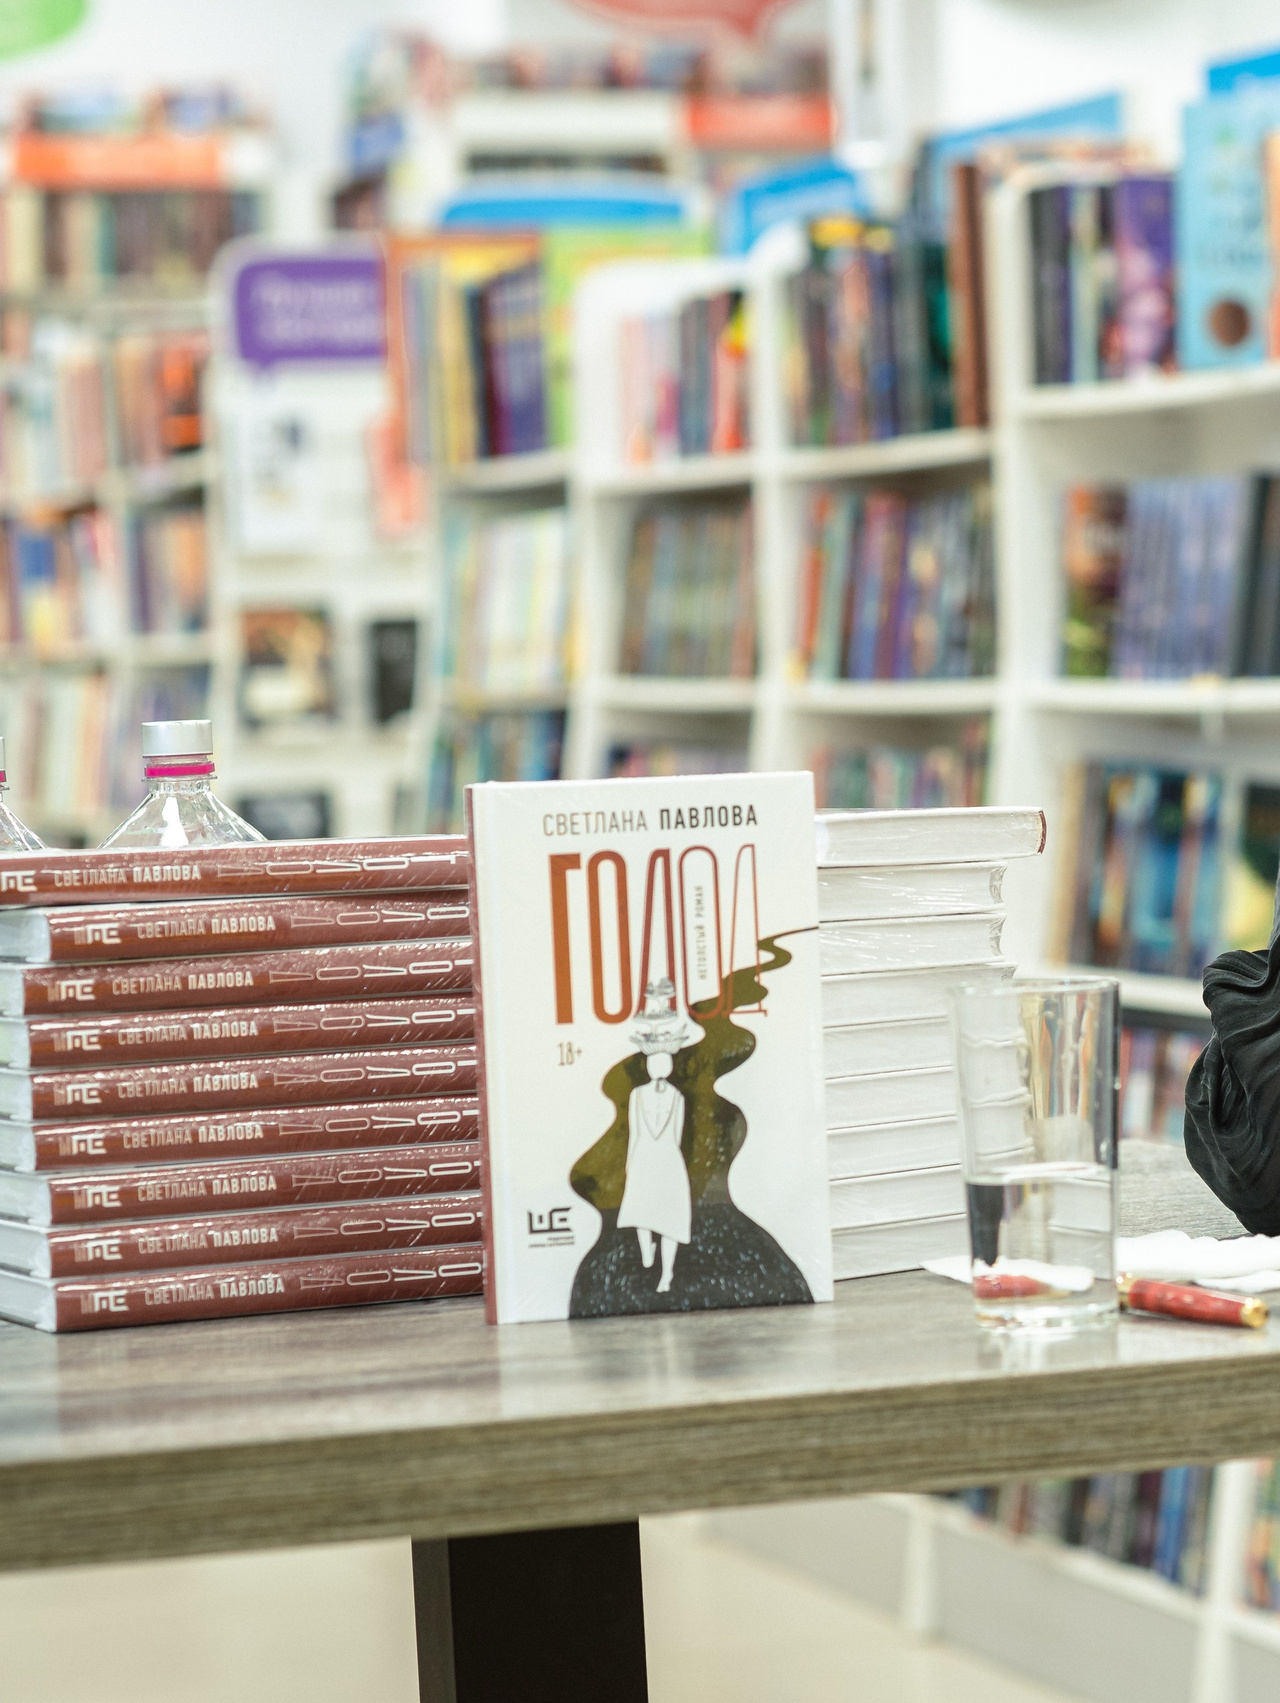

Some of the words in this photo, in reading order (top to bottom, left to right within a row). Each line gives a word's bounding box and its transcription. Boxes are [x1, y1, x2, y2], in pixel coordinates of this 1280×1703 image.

[543, 810, 648, 836] СВЕТЛАНА
[660, 804, 758, 830] ПАВЛОВА
[54, 866, 127, 886] СВЕТЛАНА
[133, 862, 201, 881] ПАВЛОВА
[694, 884, 705, 919] РОМАН
[137, 919, 206, 940] СВЕТЛАНА
[211, 914, 276, 934] ПАВЛОВА
[548, 844, 768, 1025] ГОЛОД
[112, 976, 182, 995] СВЕТЛАНА
[187, 971, 254, 990] ПАВЛОВА
[118, 1025, 188, 1046] СВЕТЛАНА
[193, 1020, 259, 1039] ПАВЛОВА
[557, 1042, 582, 1067] 18+
[117, 1077, 188, 1098] СВЕТЛАНА
[193, 1070, 259, 1090] ПАВЛОВА
[123, 1130, 193, 1149] СВЕТЛАНА
[198, 1124, 264, 1142] ПАВЛОВА
[137, 1182, 207, 1202] СВЕТЛАНА
[212, 1175, 277, 1195] ПАВЛОВА
[138, 1234, 207, 1255] СВЕТЛАНА
[213, 1226, 279, 1245] ПАВЛОВА
[144, 1286, 214, 1305] СВЕТЛАНА
[220, 1278, 285, 1298] ПАВЛОВА
